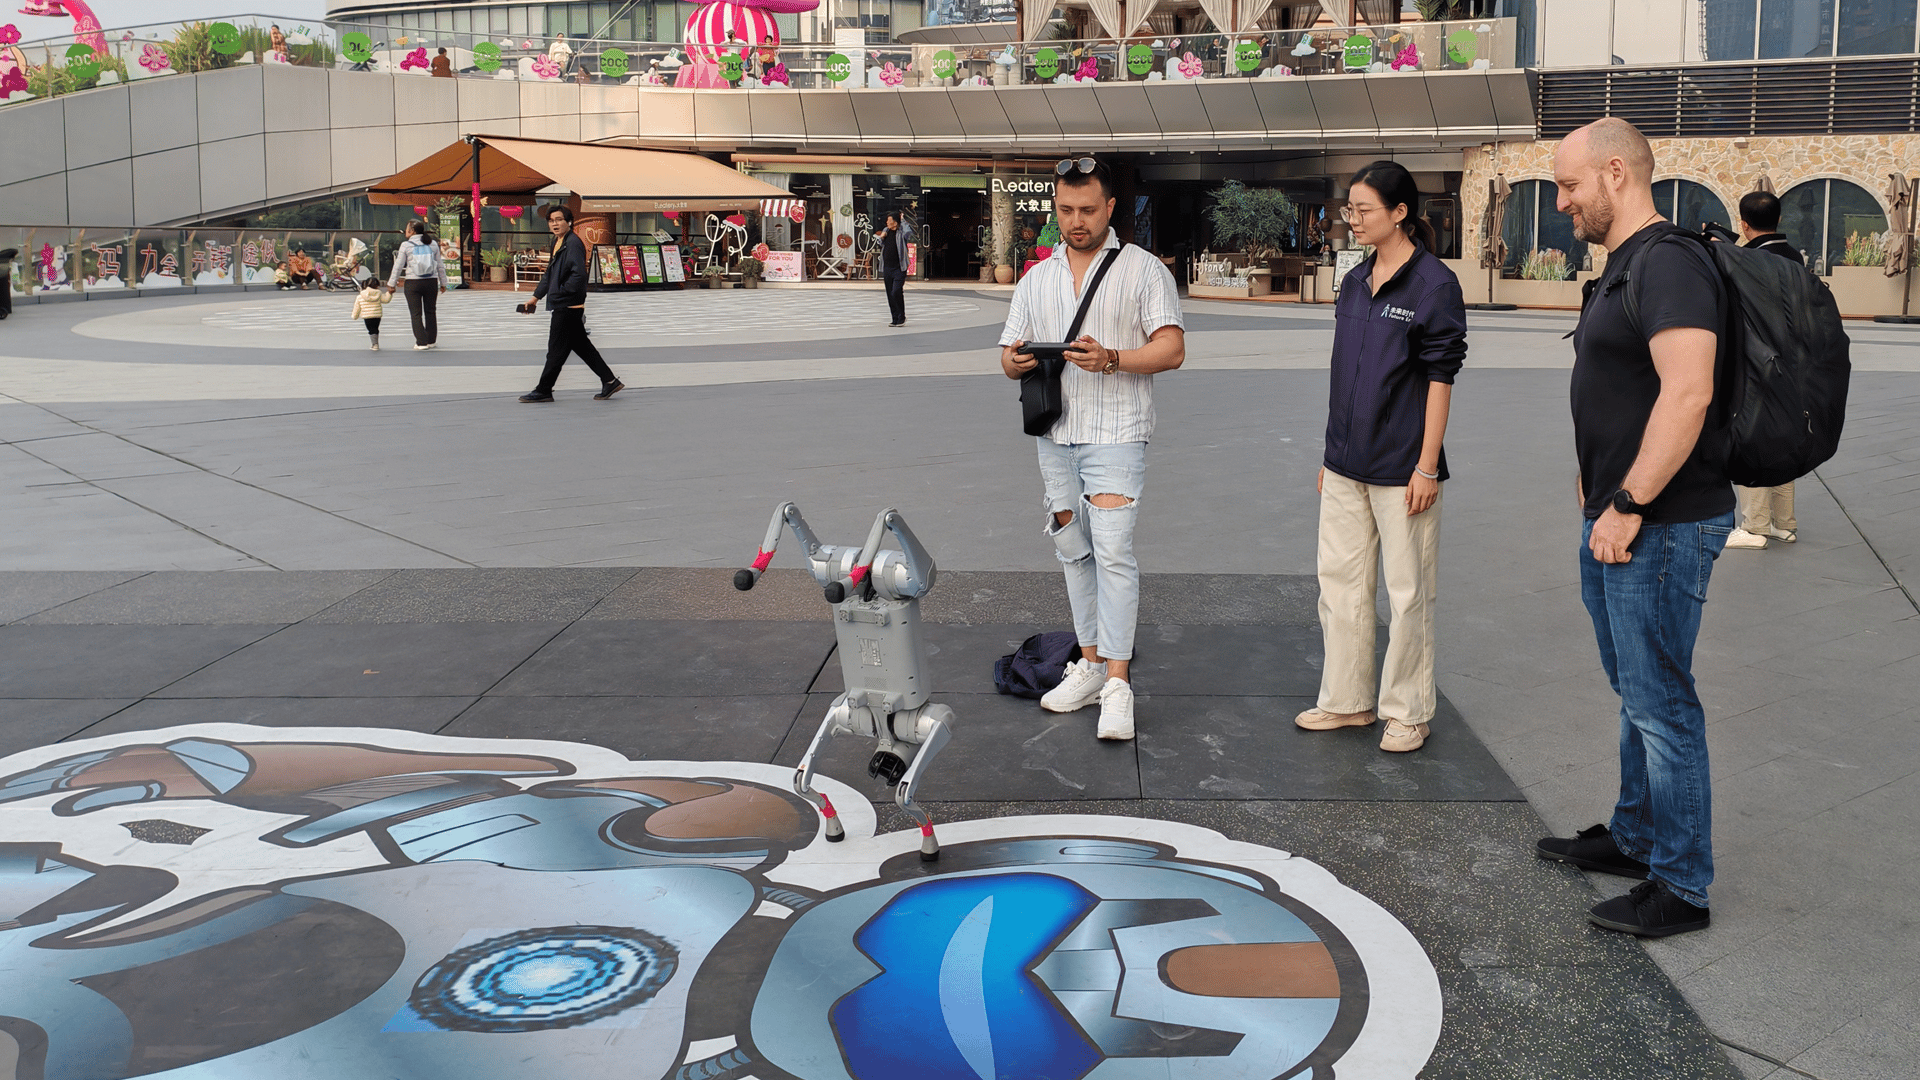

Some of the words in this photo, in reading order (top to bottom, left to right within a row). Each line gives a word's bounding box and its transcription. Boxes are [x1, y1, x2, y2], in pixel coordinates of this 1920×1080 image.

[600, 57, 629, 67] COCO
[1016, 198, 1052, 212] 大象里
[1390, 306, 1415, 319] 未来时代
